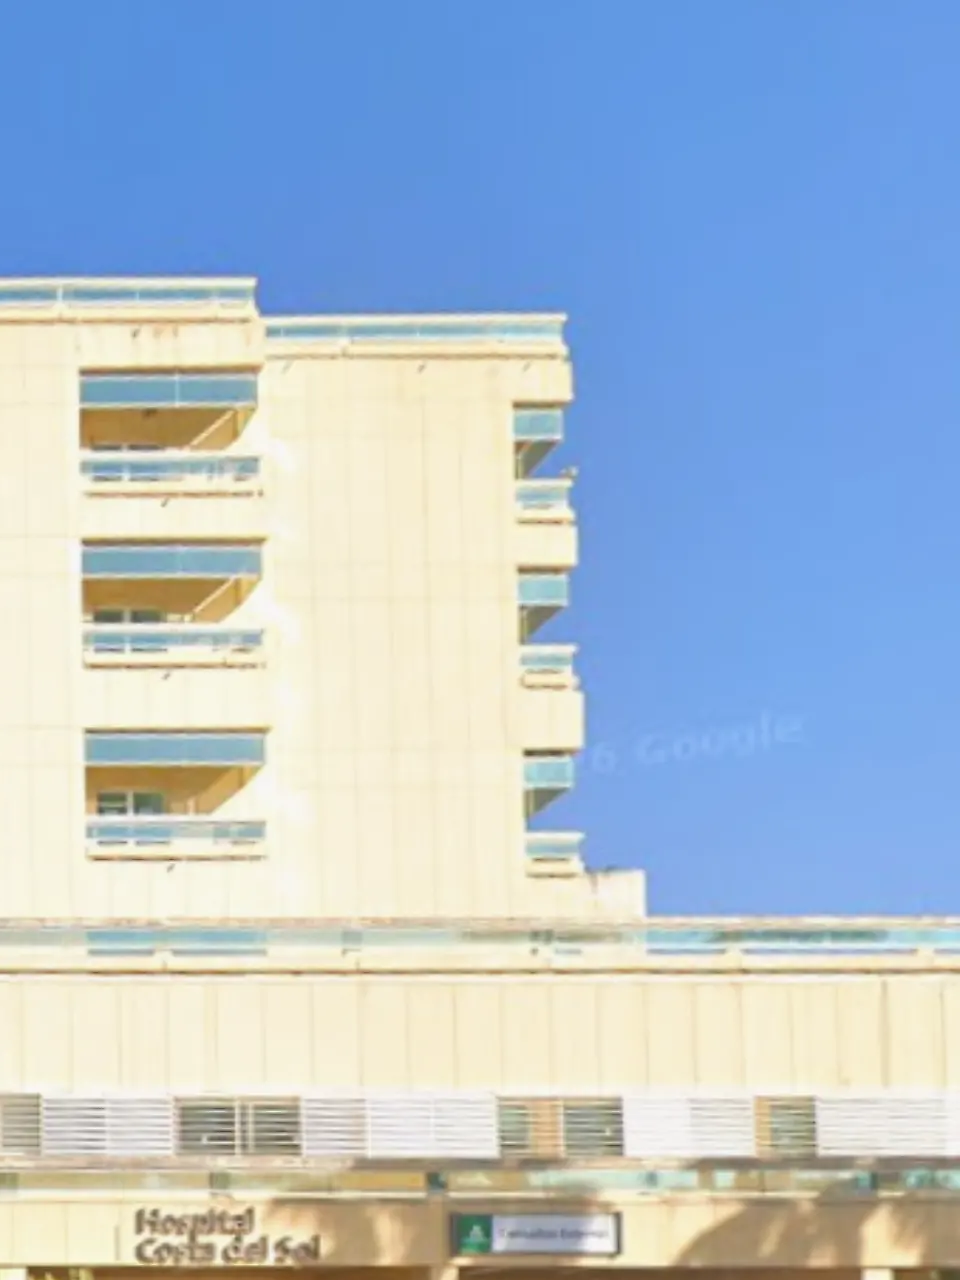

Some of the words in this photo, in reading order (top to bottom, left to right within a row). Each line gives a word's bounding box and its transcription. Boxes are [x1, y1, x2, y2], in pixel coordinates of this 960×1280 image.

[135, 1207, 254, 1242] Hospital
[135, 1236, 216, 1263] Costa
[221, 1234, 268, 1263] del
[273, 1234, 321, 1263] Sol
